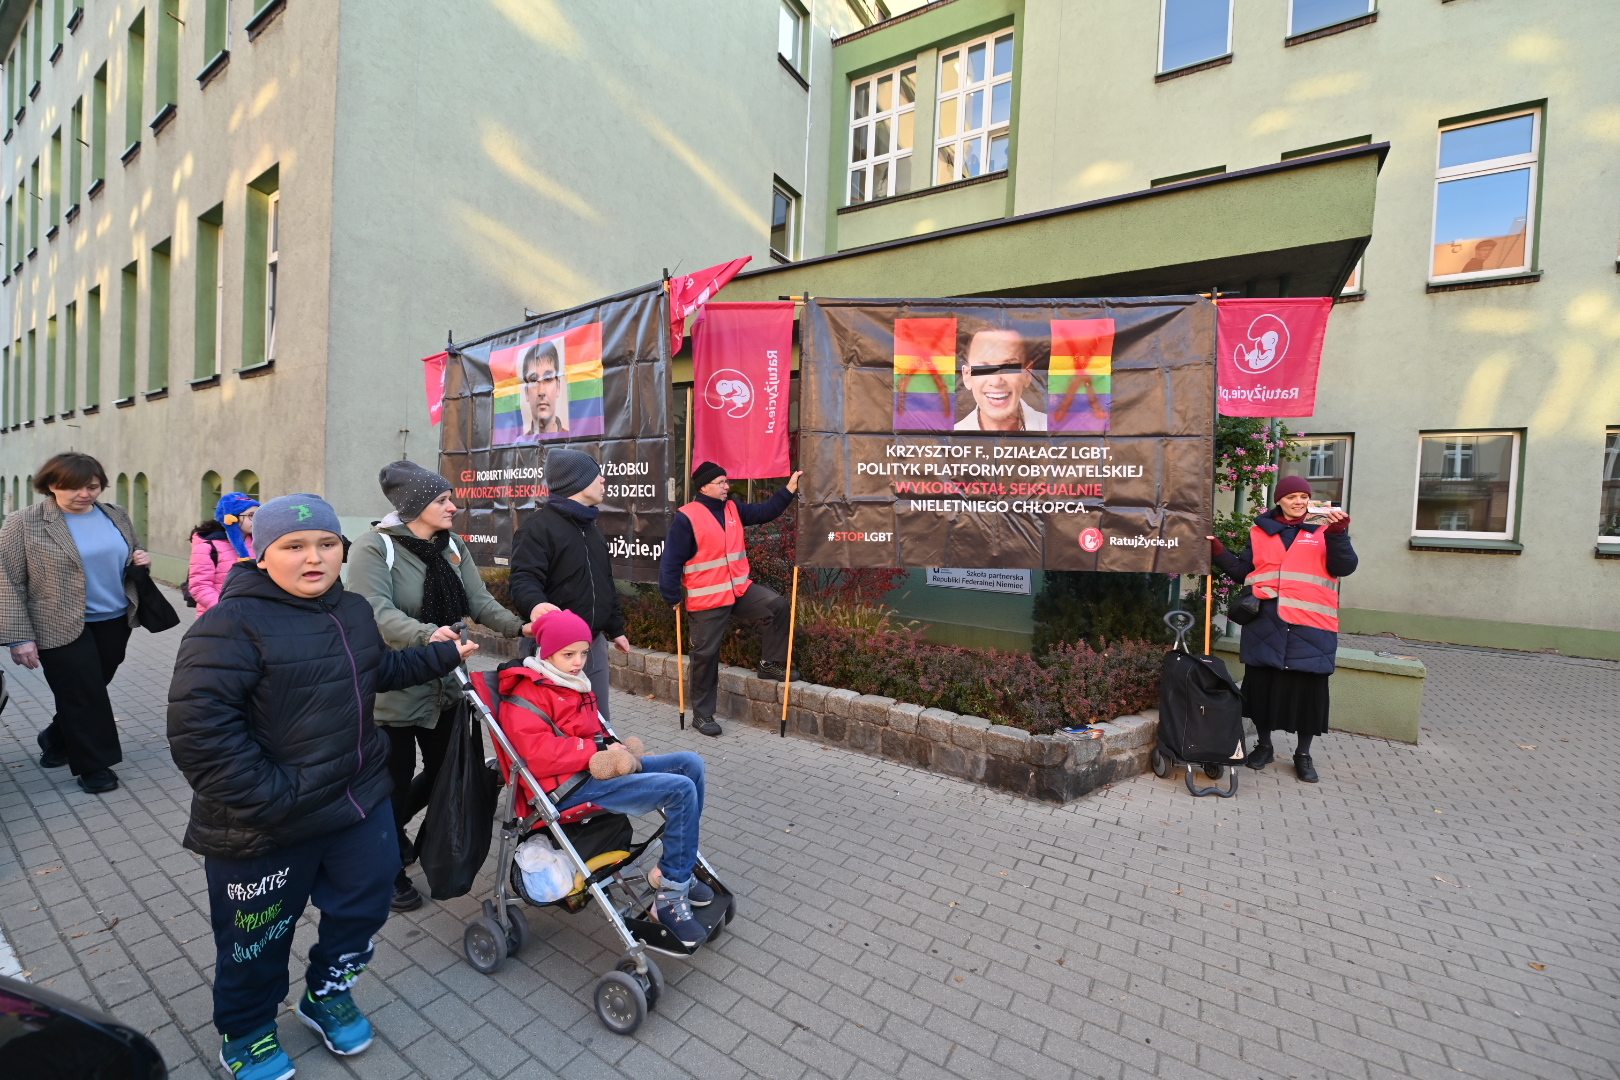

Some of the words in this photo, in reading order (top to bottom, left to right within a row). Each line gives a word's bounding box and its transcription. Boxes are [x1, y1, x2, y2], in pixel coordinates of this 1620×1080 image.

[886, 445, 972, 458] KRZYSZTOF
[975, 446, 989, 460] F.,
[993, 446, 1068, 459] DZIAŁACZ
[1071, 447, 1113, 461] LGBT,
[460, 470, 476, 482] GEJ
[606, 460, 649, 476] ŻŁOBKU
[857, 462, 921, 475] POLITYK
[924, 463, 1015, 477] PLATFORMY
[1017, 464, 1144, 478] OBYWATELSKIEJ
[454, 485, 514, 499] WYKORZYSTAŁ
[607, 484, 619, 497] 53
[895, 481, 1007, 495] WYKORZYSTAŁ
[1009, 482, 1103, 496] SEKSUALNIE
[910, 499, 1009, 513] NIELETNIEGO
[1012, 501, 1090, 514] CHŁOPCA.
[827, 531, 893, 542] #STOPLGBT
[1109, 534, 1179, 549] RatujŻycie.pl
[607, 535, 665, 561] ujŻycie.pl
[932, 575, 961, 584] Republiki
[961, 577, 995, 588] Federalnej
[996, 582, 1024, 590] Niemiec
[966, 569, 987, 578] Szkoła
[988, 572, 1024, 581] partnerska
